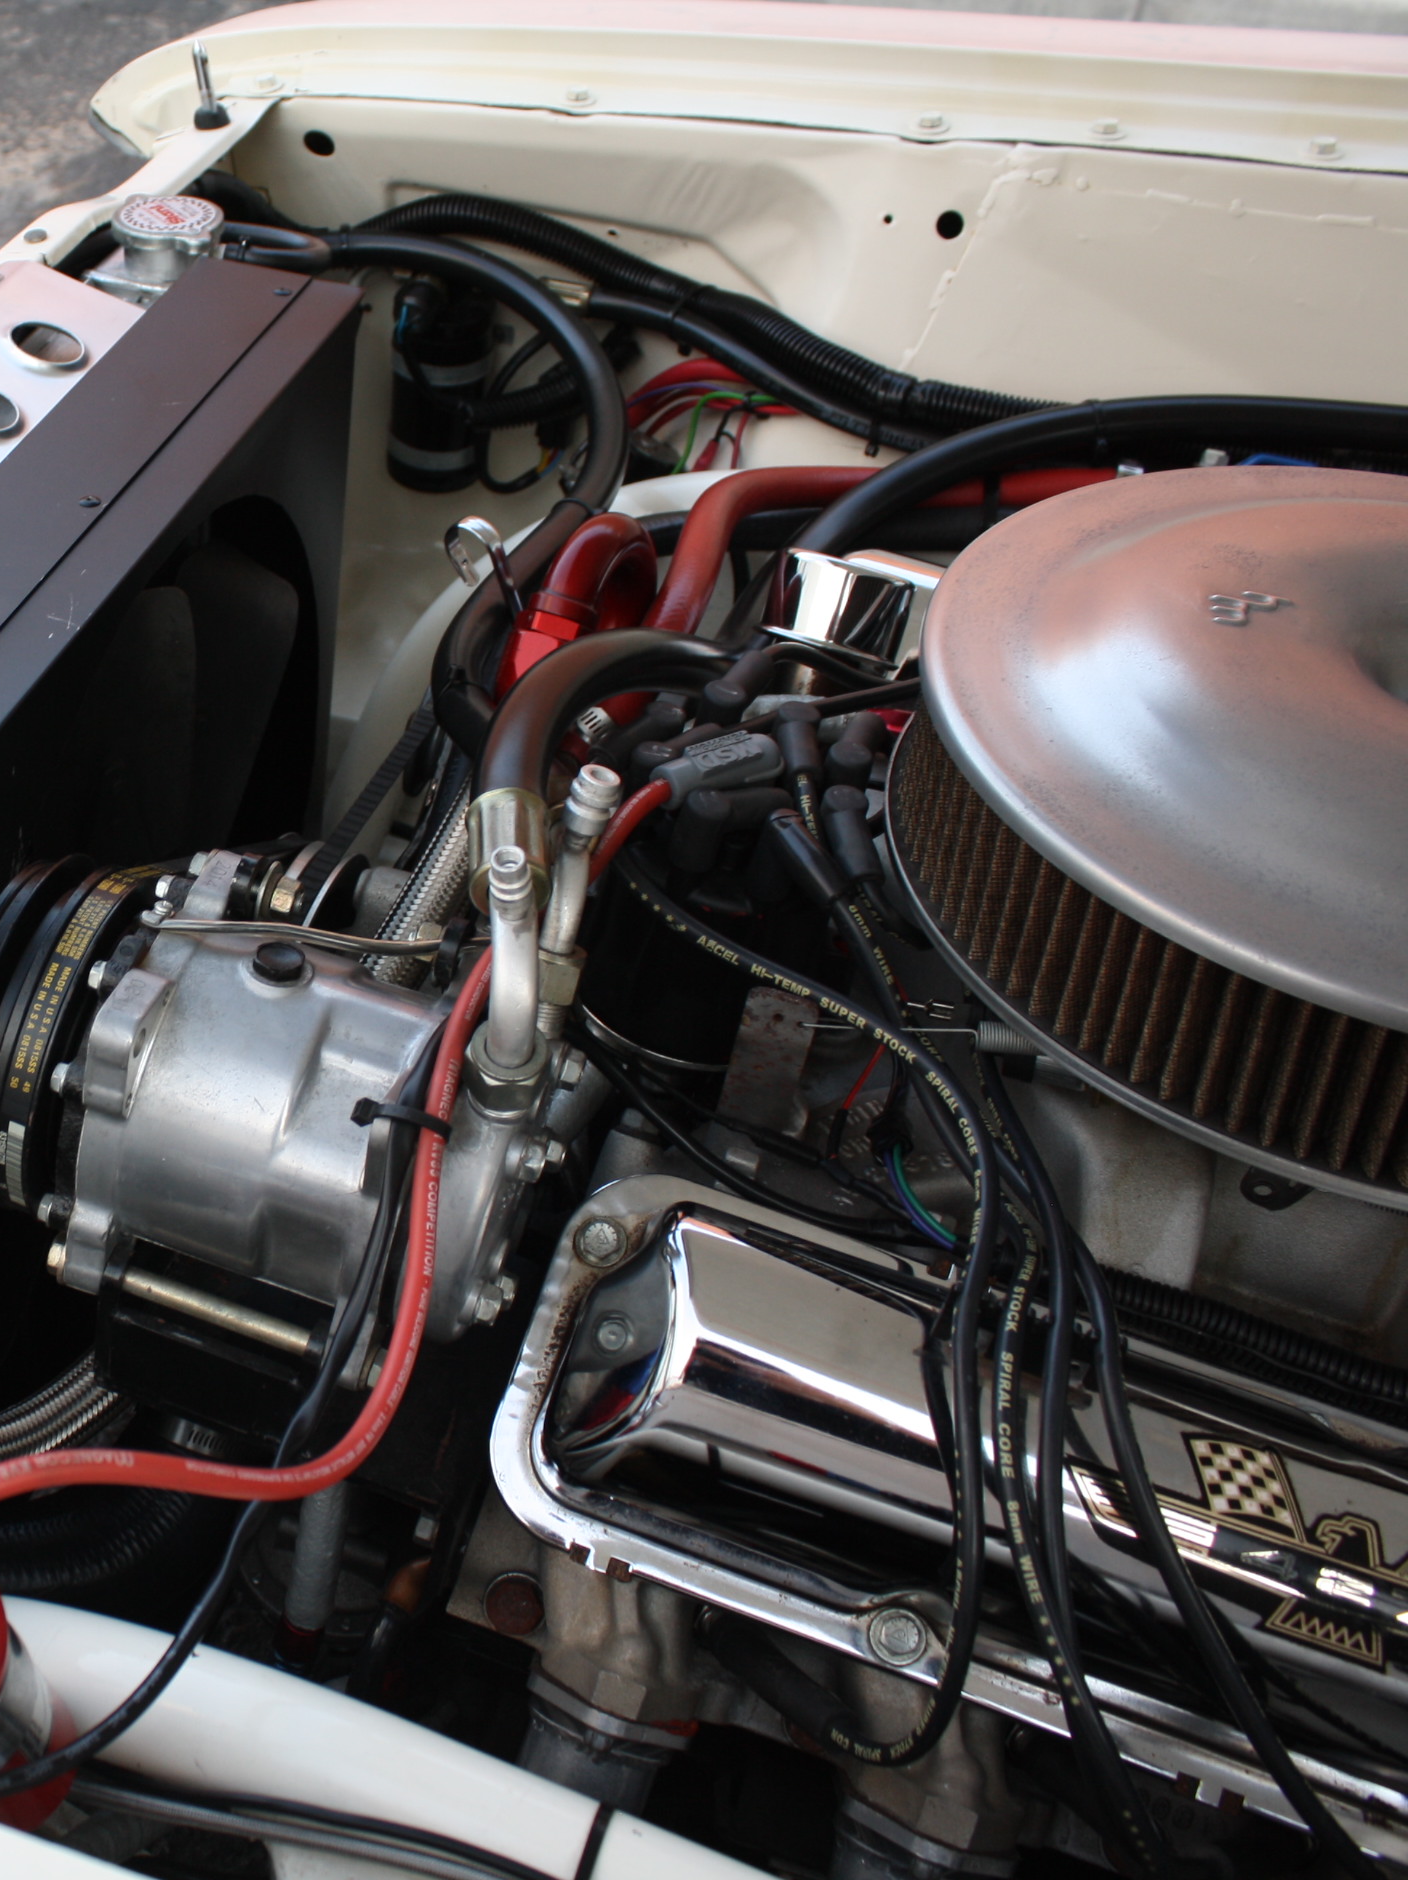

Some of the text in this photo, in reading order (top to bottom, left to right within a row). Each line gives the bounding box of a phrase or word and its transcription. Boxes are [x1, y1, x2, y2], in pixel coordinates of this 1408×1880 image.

[36, 990, 47, 1001] IN
[41, 962, 60, 989] MADE
[56, 966, 72, 993] MADE
[49, 994, 60, 1005] IN
[750, 963, 811, 997] HI-TEMP
[819, 997, 866, 1029] SUPER
[873, 1027, 917, 1064] STOCK
[925, 1071, 959, 1114] SPIRAL
[958, 1117, 978, 1157] CORE
[423, 1181, 439, 1277] COMPETITION
[1018, 1254, 1038, 1282] SUPER
[1004, 1285, 1026, 1333] STOCK
[997, 1350, 1014, 1411] SPIRAL
[998, 1422, 1016, 1479] CORE
[1007, 1500, 1024, 1544] 8mm
[1019, 1554, 1044, 1604] WIRE
